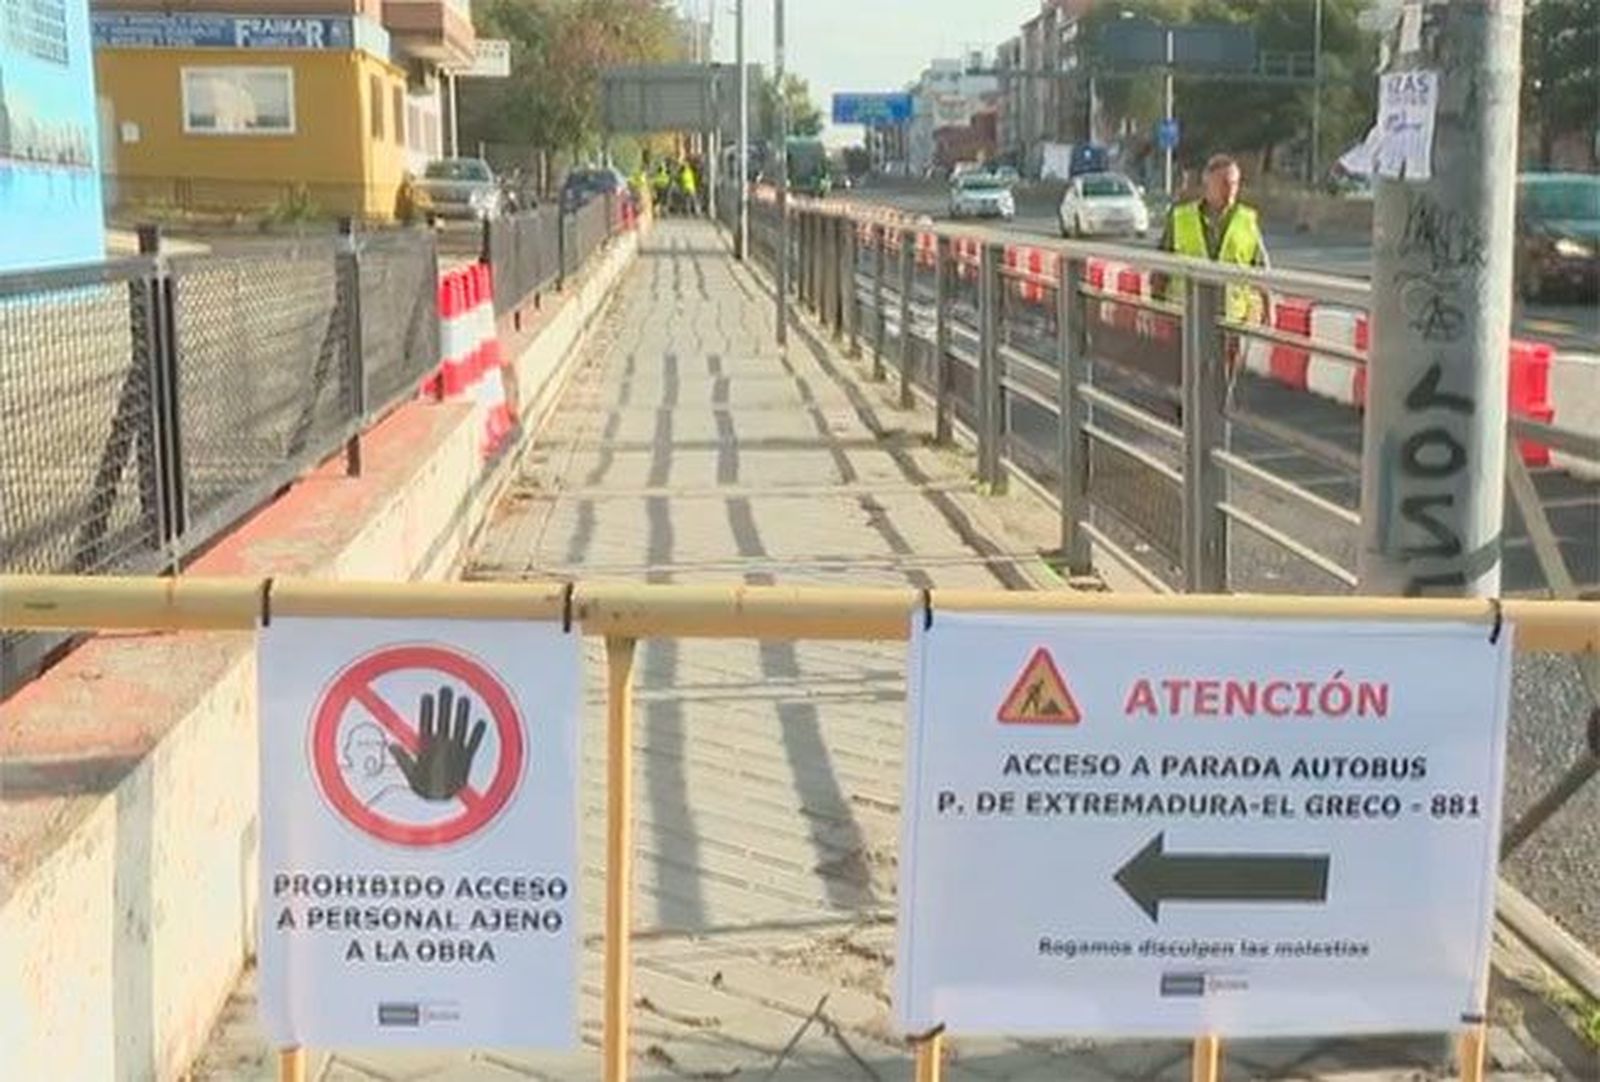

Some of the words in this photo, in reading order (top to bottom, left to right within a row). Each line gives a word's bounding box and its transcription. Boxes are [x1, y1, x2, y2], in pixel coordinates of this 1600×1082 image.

[1124, 670, 1389, 719] ATENCIÓN
[1003, 753, 1121, 777] ACCESO
[1131, 755, 1150, 777] A
[1161, 756, 1281, 778] PARADA
[1290, 756, 1428, 780] AUTOBUS
[938, 790, 965, 813] P.
[976, 791, 1016, 815] DE
[1026, 792, 1295, 817] EXTREMADURA-EL
[1305, 794, 1401, 818] GRECO
[1430, 794, 1481, 818] 881
[273, 873, 445, 899] PROHIBIDO
[455, 876, 568, 900] ACCESO
[277, 908, 296, 930] A
[307, 907, 460, 932] PERSONAL
[469, 909, 563, 932] AJENO
[346, 940, 364, 962] A
[374, 940, 410, 962] LA
[416, 940, 496, 963] OBRA
[1038, 936, 1132, 958] Rogamos
[1138, 938, 1234, 960] disculpen
[1241, 940, 1268, 956] las
[1274, 938, 1369, 958] molestias
